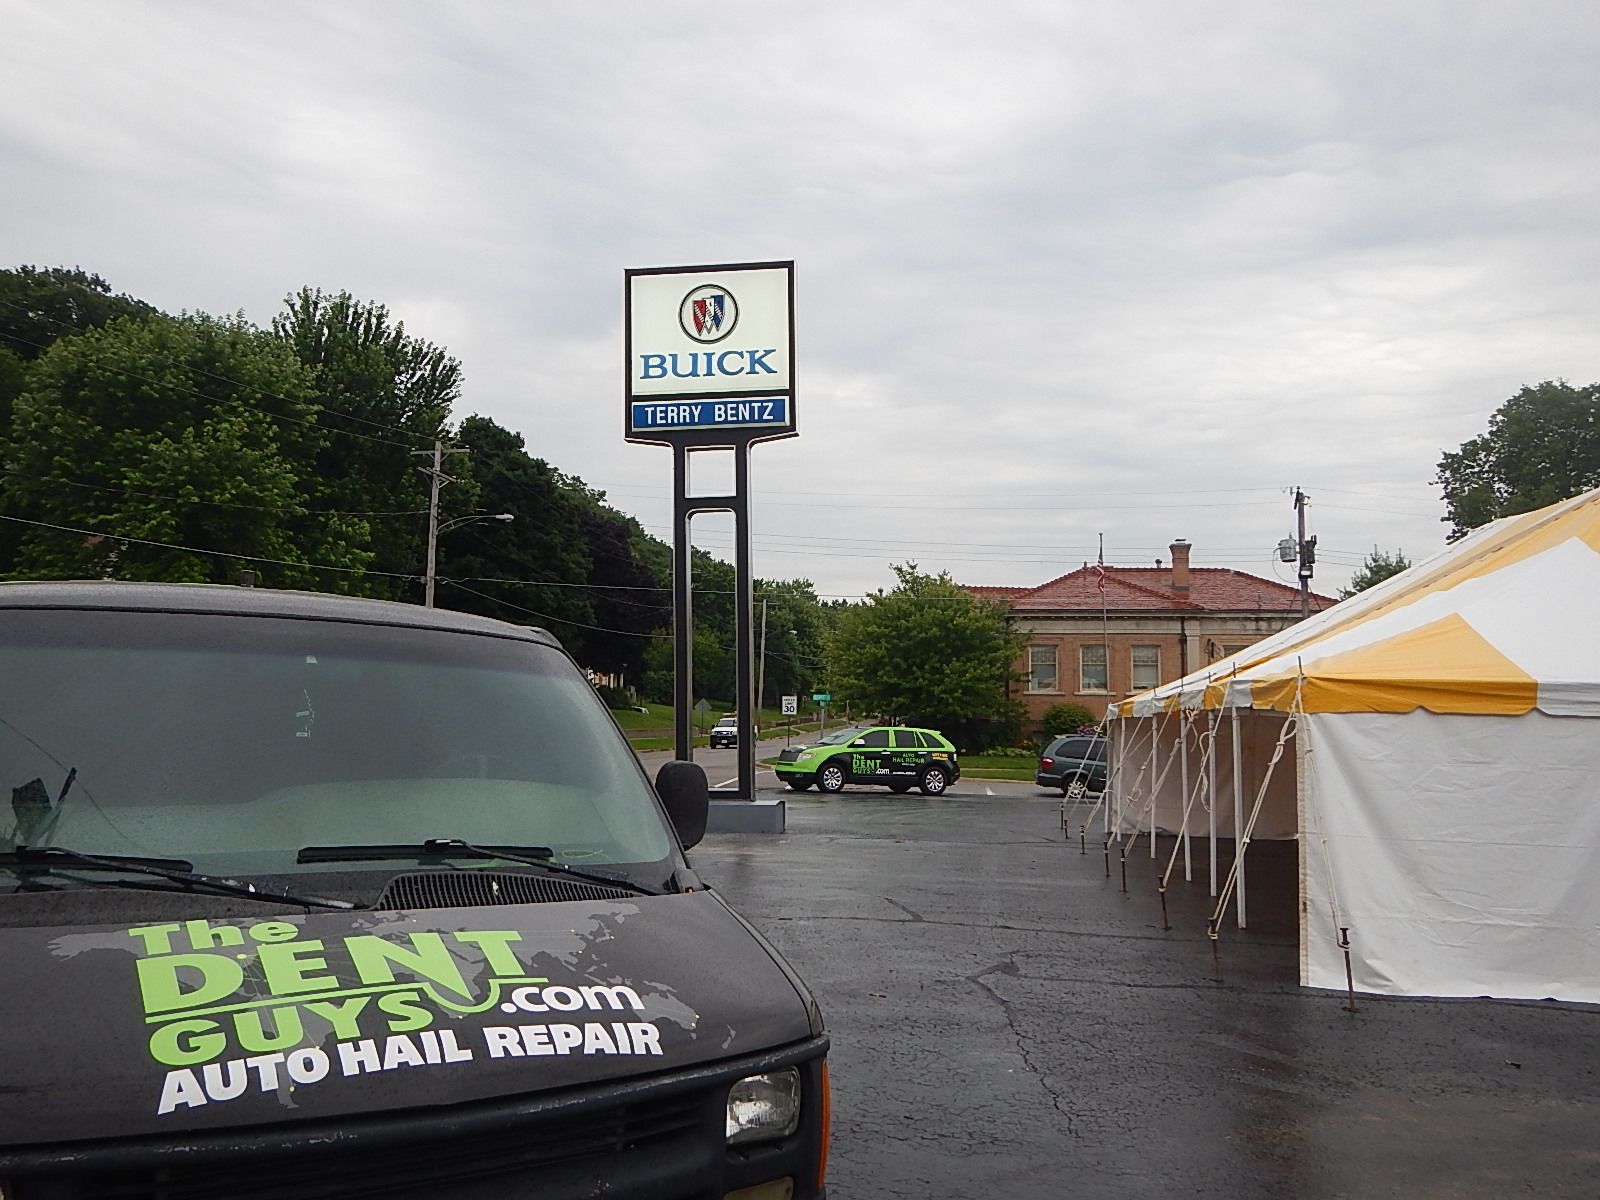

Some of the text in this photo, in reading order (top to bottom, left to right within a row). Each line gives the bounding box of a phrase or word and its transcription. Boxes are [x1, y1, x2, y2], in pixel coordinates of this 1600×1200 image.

[639, 349, 778, 379] BUICK
[644, 402, 774, 424] TERRY BENTZ
[783, 705, 795, 713] 30
[852, 759, 882, 768] DENT
[129, 920, 298, 955] The
[136, 930, 527, 1014] DENT
[149, 984, 646, 1066] GUYS .com
[157, 1022, 664, 1115] AUTO HAIL REPAIR
